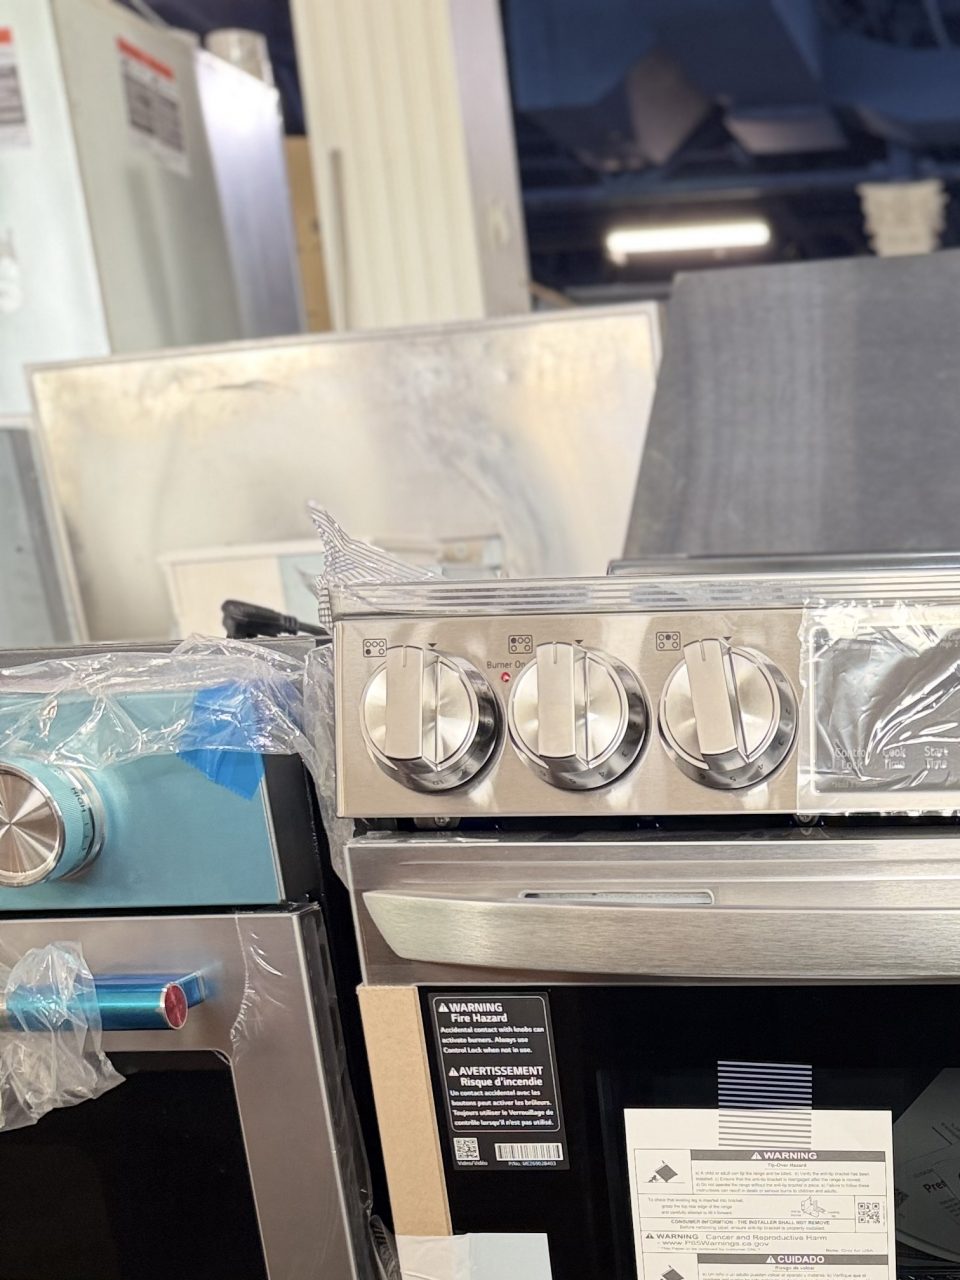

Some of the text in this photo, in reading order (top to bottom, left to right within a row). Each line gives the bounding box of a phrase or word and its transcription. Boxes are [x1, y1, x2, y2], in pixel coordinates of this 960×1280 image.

[486, 660, 526, 669] Burner On
[924, 746, 949, 757] Start
[925, 758, 948, 770] Time
[70, 786, 87, 813] HIGH
[449, 1003, 503, 1012] WARNING
[451, 1013, 508, 1023] Fire Hazard
[459, 1066, 544, 1076] AVERTISSEMENT
[460, 1077, 543, 1088] Risque d'incendie
[763, 1152, 818, 1160] WARNING
[777, 1255, 825, 1264] CUIDADO
